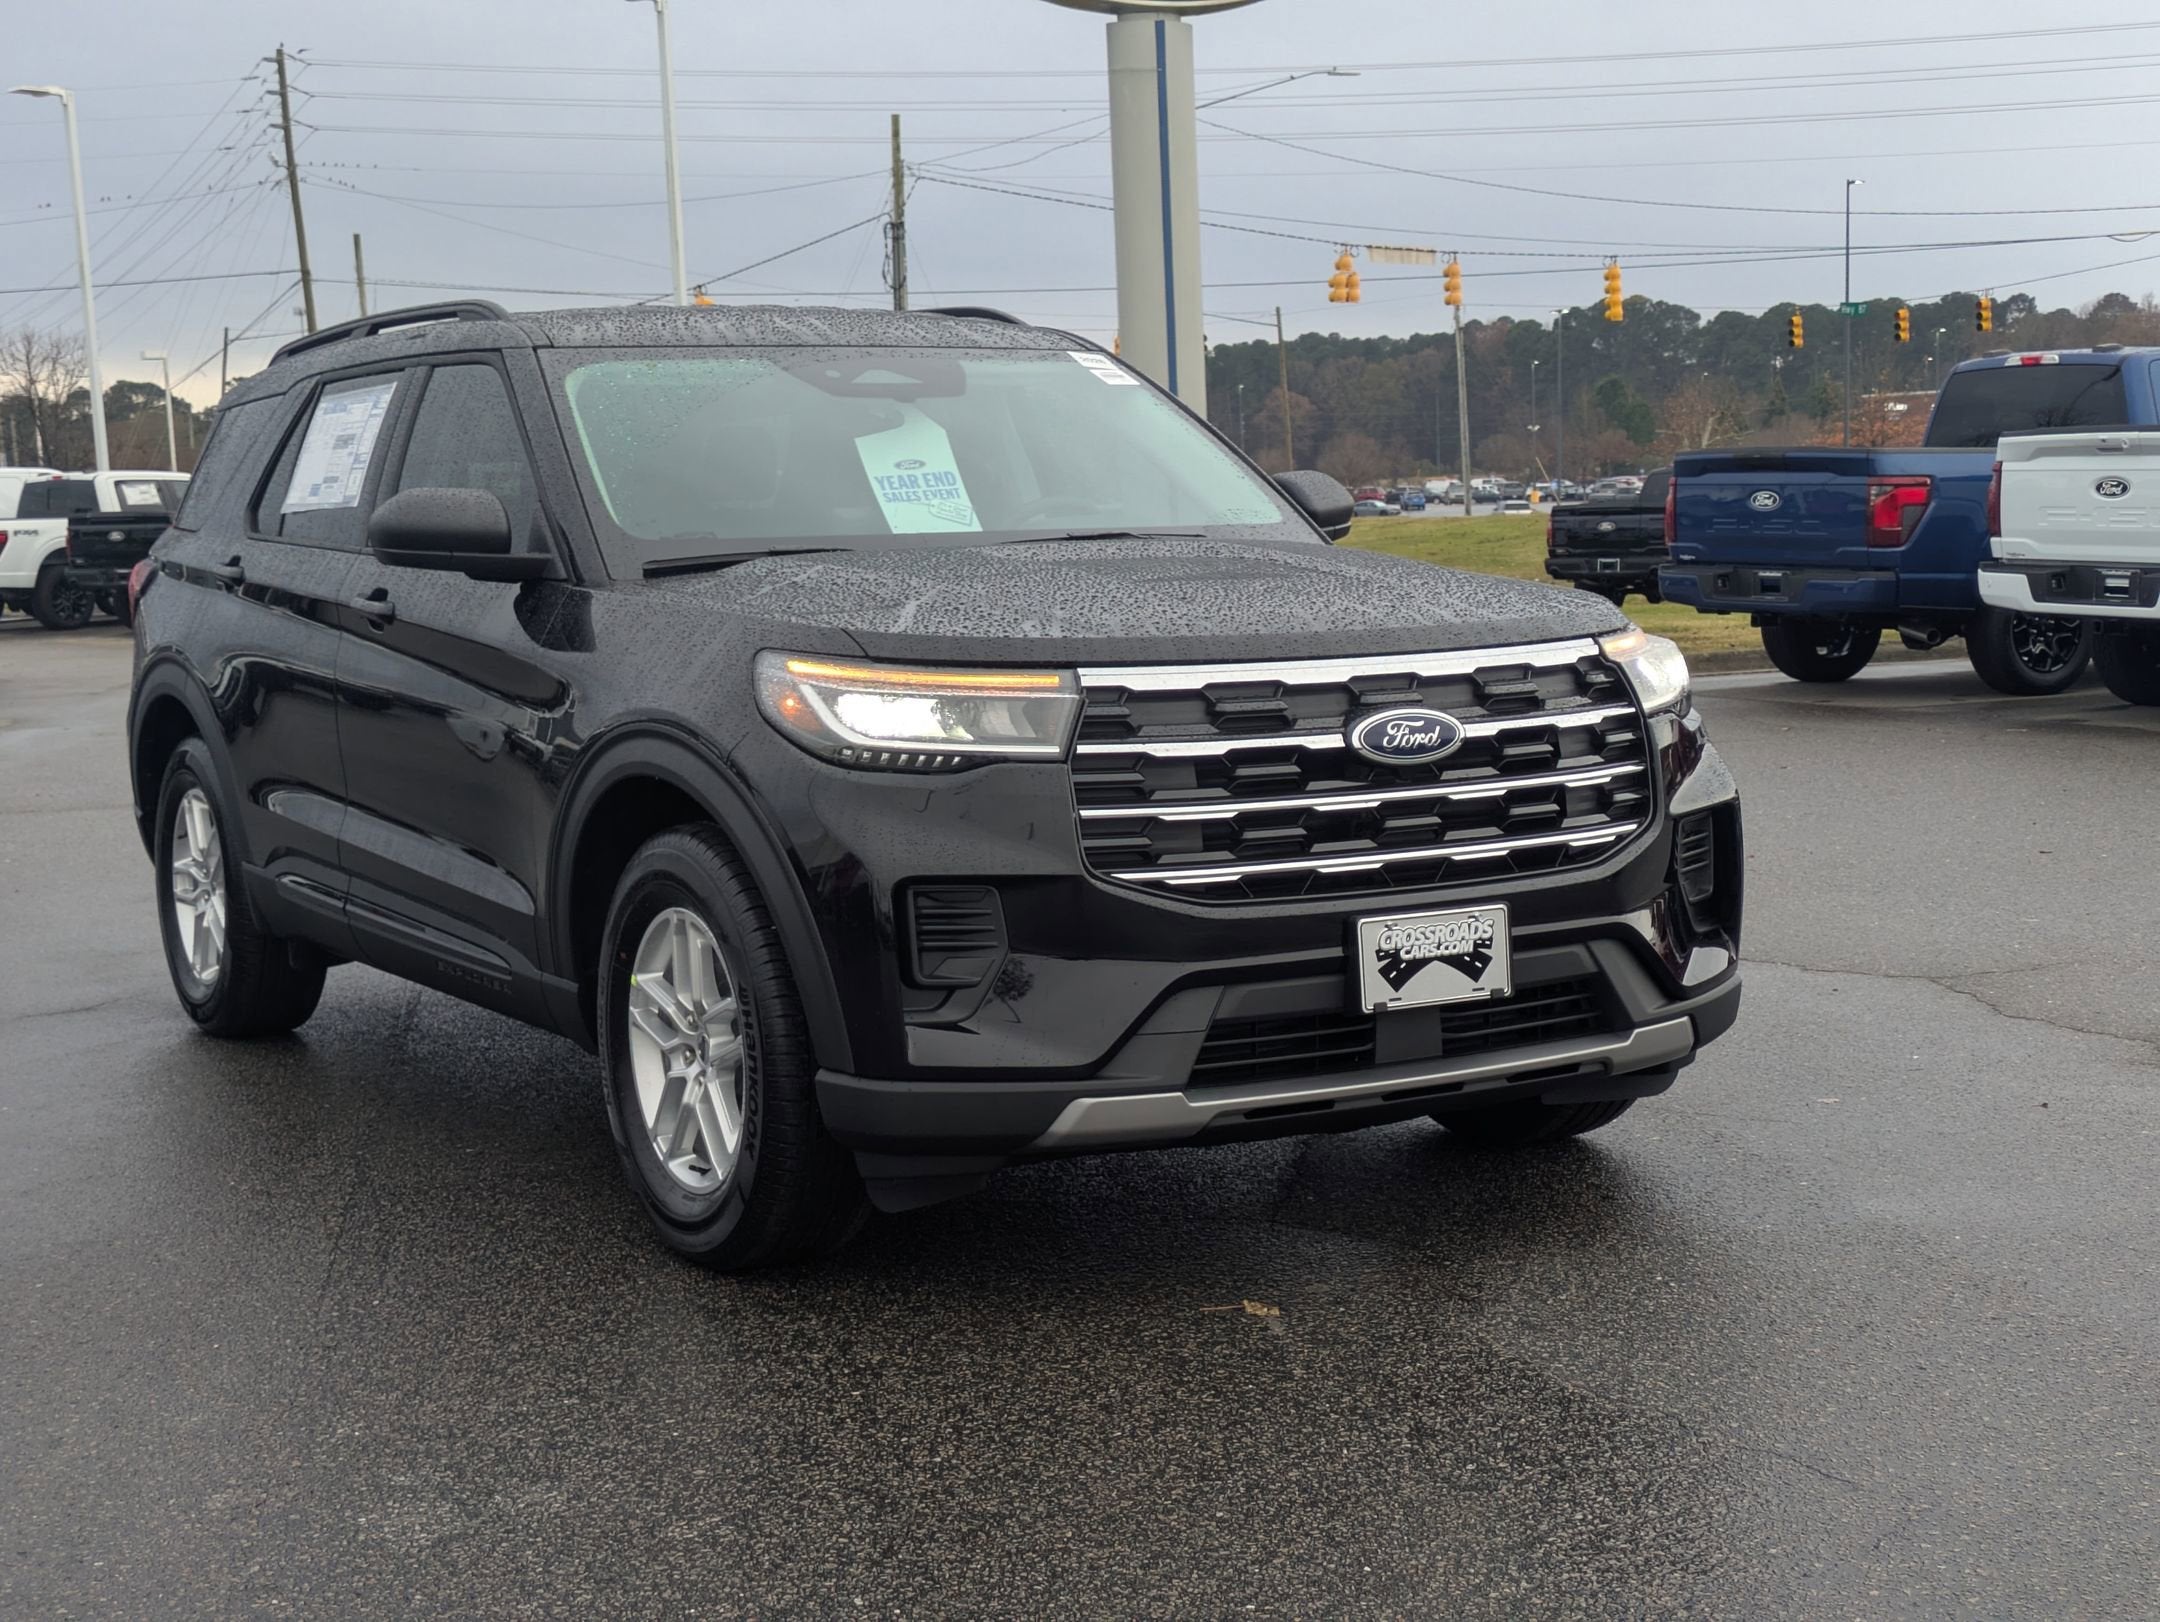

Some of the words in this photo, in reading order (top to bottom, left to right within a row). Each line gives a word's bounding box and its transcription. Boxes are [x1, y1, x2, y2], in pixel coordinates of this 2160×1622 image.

[874, 474, 920, 491] YEAR
[922, 471, 957, 488] END
[2099, 481, 2124, 495] Ford
[883, 490, 922, 503] SALES
[922, 488, 961, 501] EVENT
[1383, 719, 1441, 750] Ford
[1378, 919, 1495, 951] CROSSROADS
[1400, 940, 1475, 960] CARS.COM
